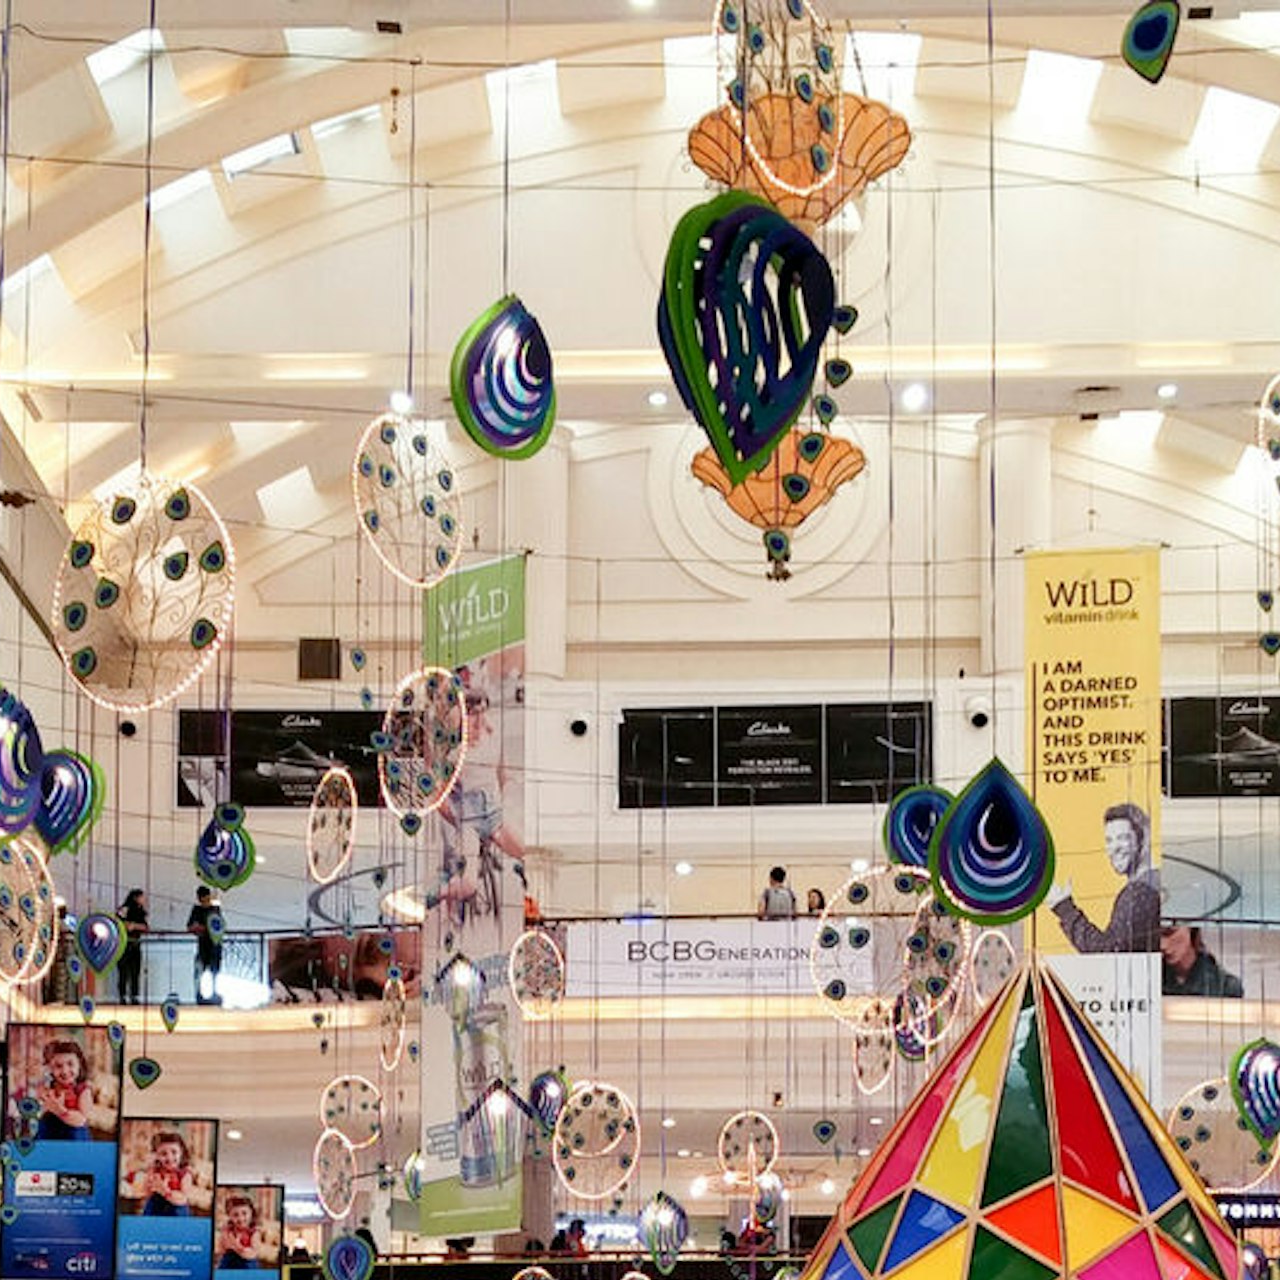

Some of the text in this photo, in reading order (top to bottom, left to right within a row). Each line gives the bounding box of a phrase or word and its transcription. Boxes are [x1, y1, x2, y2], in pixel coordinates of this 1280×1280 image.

[1045, 578, 1133, 608] WILD
[439, 586, 509, 632] WILD
[1044, 611, 1102, 624] vitamin
[1043, 661, 1082, 675] I AM
[1043, 677, 1137, 693] A DARNED
[1043, 696, 1133, 711] OPTIMIST.
[1043, 716, 1084, 729] AND
[1044, 731, 1147, 748] THIS DRINK
[1043, 751, 1087, 766] SAYS
[1044, 770, 1067, 783] TO
[66, 1256, 97, 1271] citi
